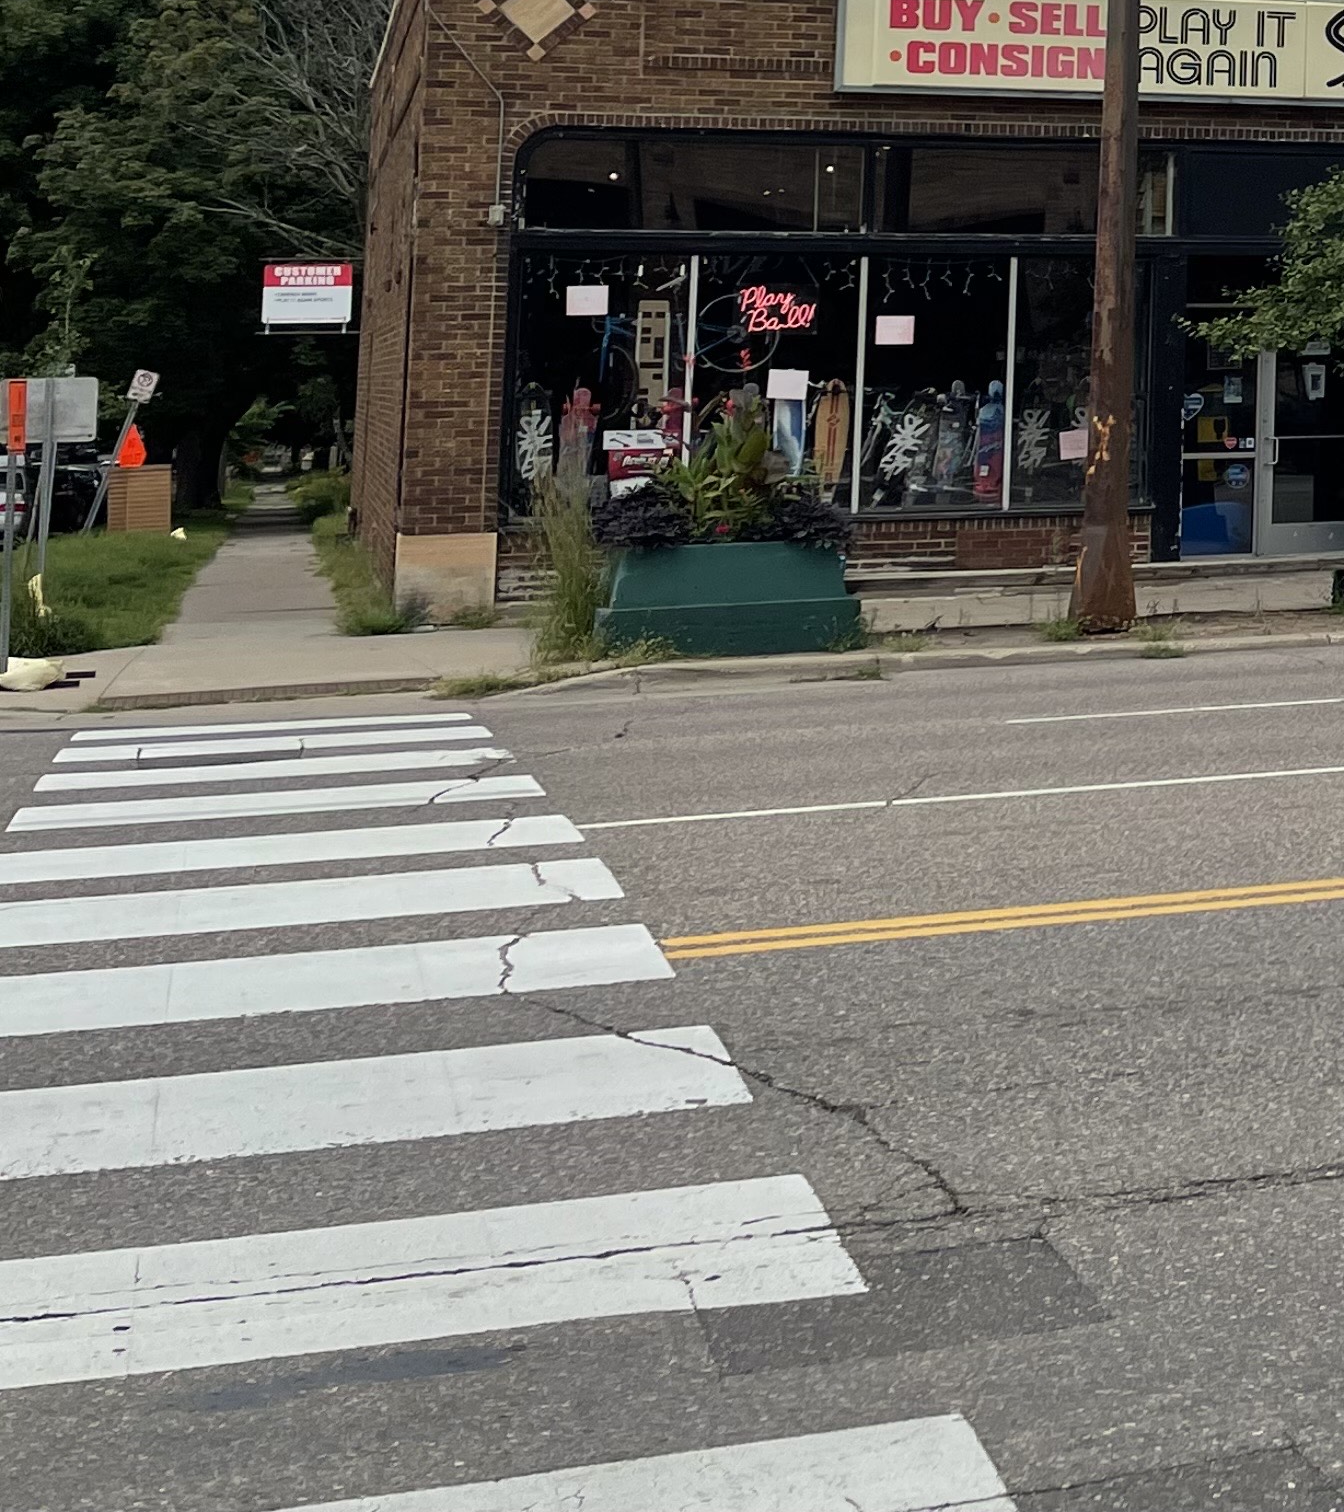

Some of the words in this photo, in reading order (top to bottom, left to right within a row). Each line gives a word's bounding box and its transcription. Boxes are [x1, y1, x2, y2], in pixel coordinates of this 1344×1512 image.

[1008, 1, 1107, 37] SELL
[1256, 10, 1297, 48] IT
[906, 39, 1105, 80] CONSIGN
[274, 266, 342, 276] CUSTOMER
[280, 276, 335, 286] PARKING
[739, 285, 796, 314] Play
[747, 303, 817, 332] Ball!
